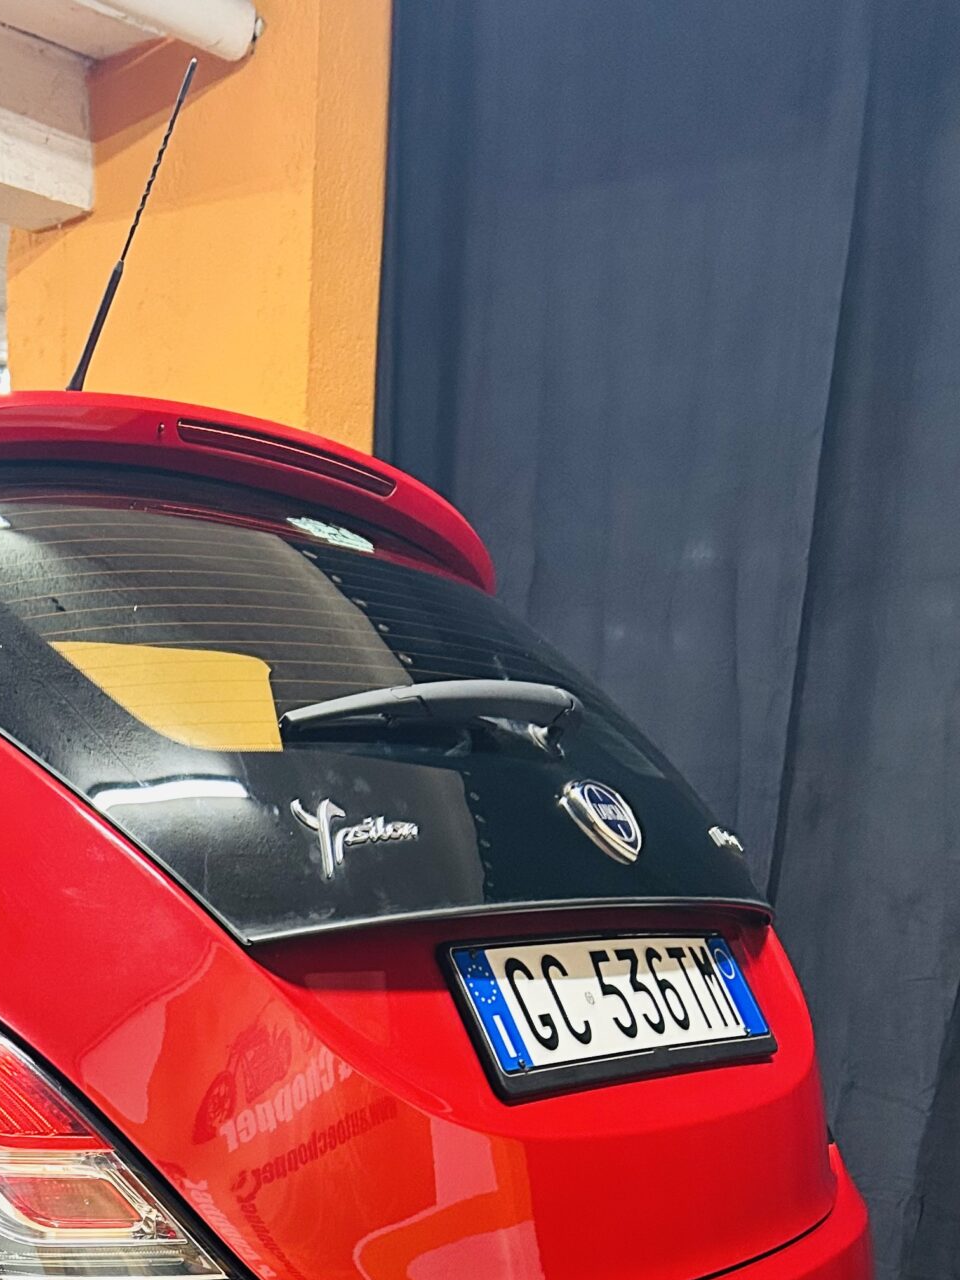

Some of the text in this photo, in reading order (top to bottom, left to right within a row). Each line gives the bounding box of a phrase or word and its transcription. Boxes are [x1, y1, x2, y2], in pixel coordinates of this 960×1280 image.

[290, 798, 419, 879] Ypsilon
[504, 946, 740, 1051] GC 536TM
